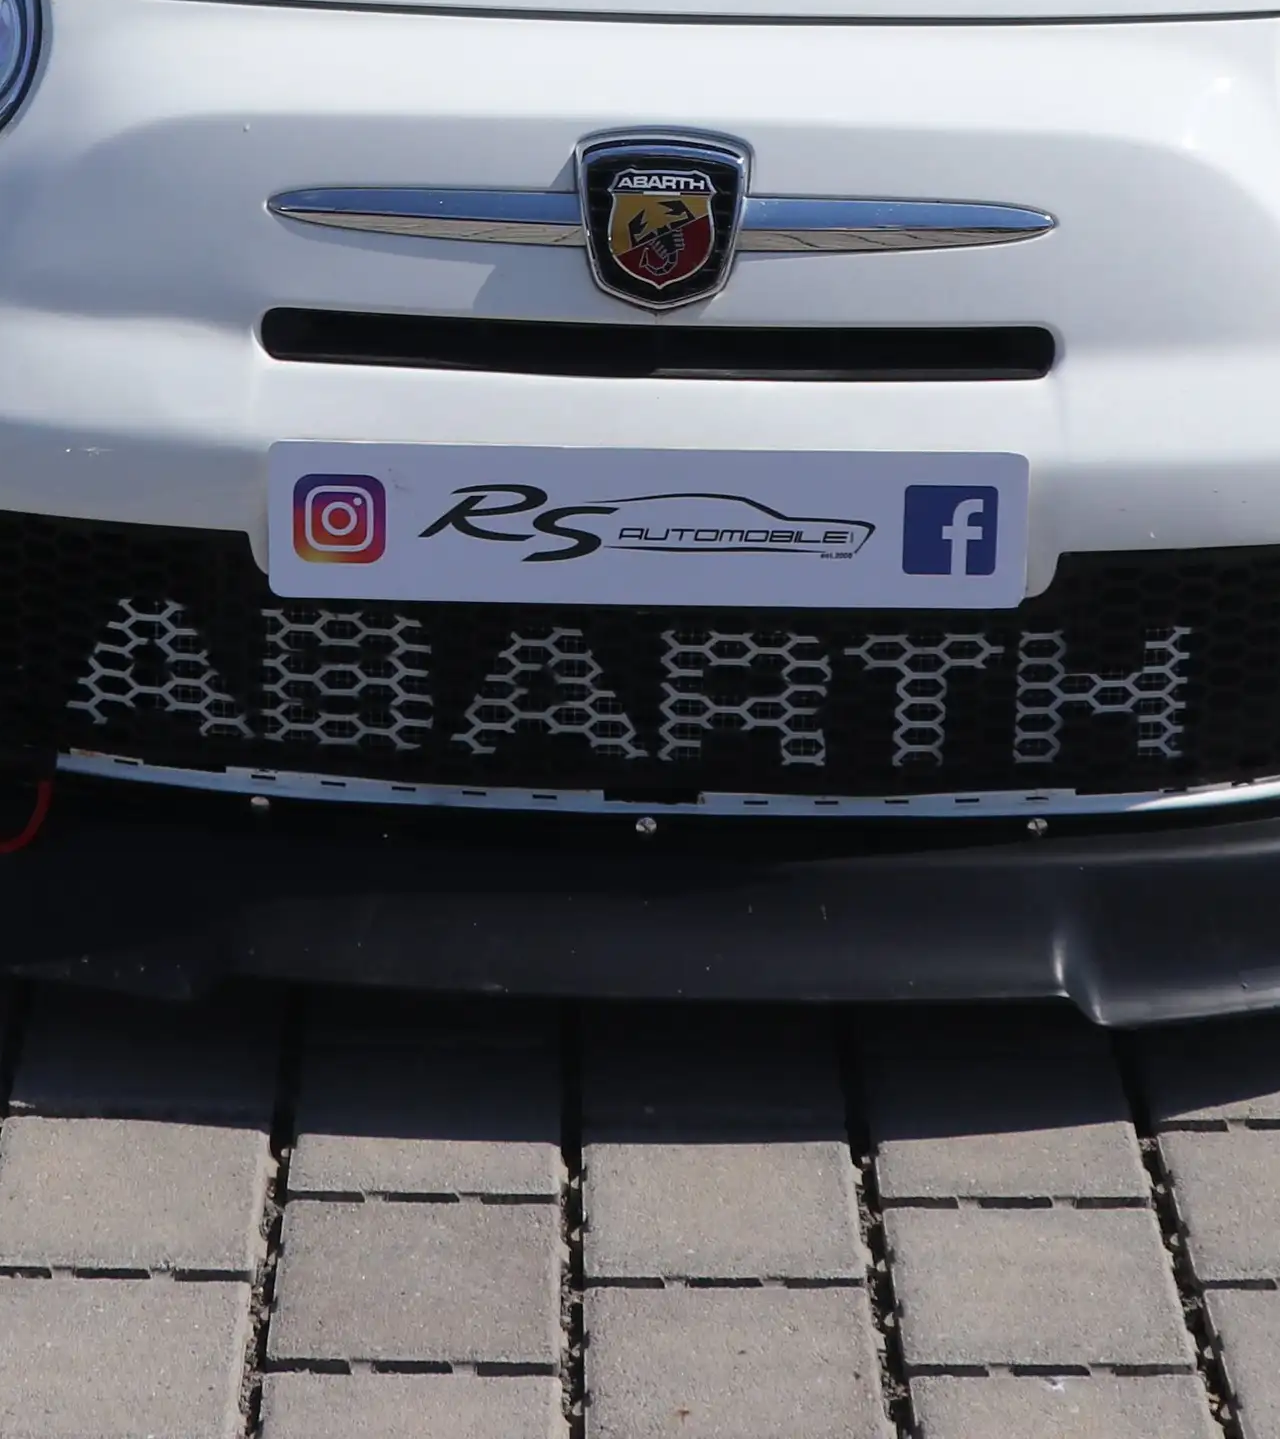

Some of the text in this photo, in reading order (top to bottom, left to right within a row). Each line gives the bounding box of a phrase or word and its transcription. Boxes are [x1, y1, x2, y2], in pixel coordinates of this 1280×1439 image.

[618, 175, 705, 191] ABARTH
[418, 484, 850, 562] RS AUTOMOBILE
[66, 598, 1192, 766] ABARTH
